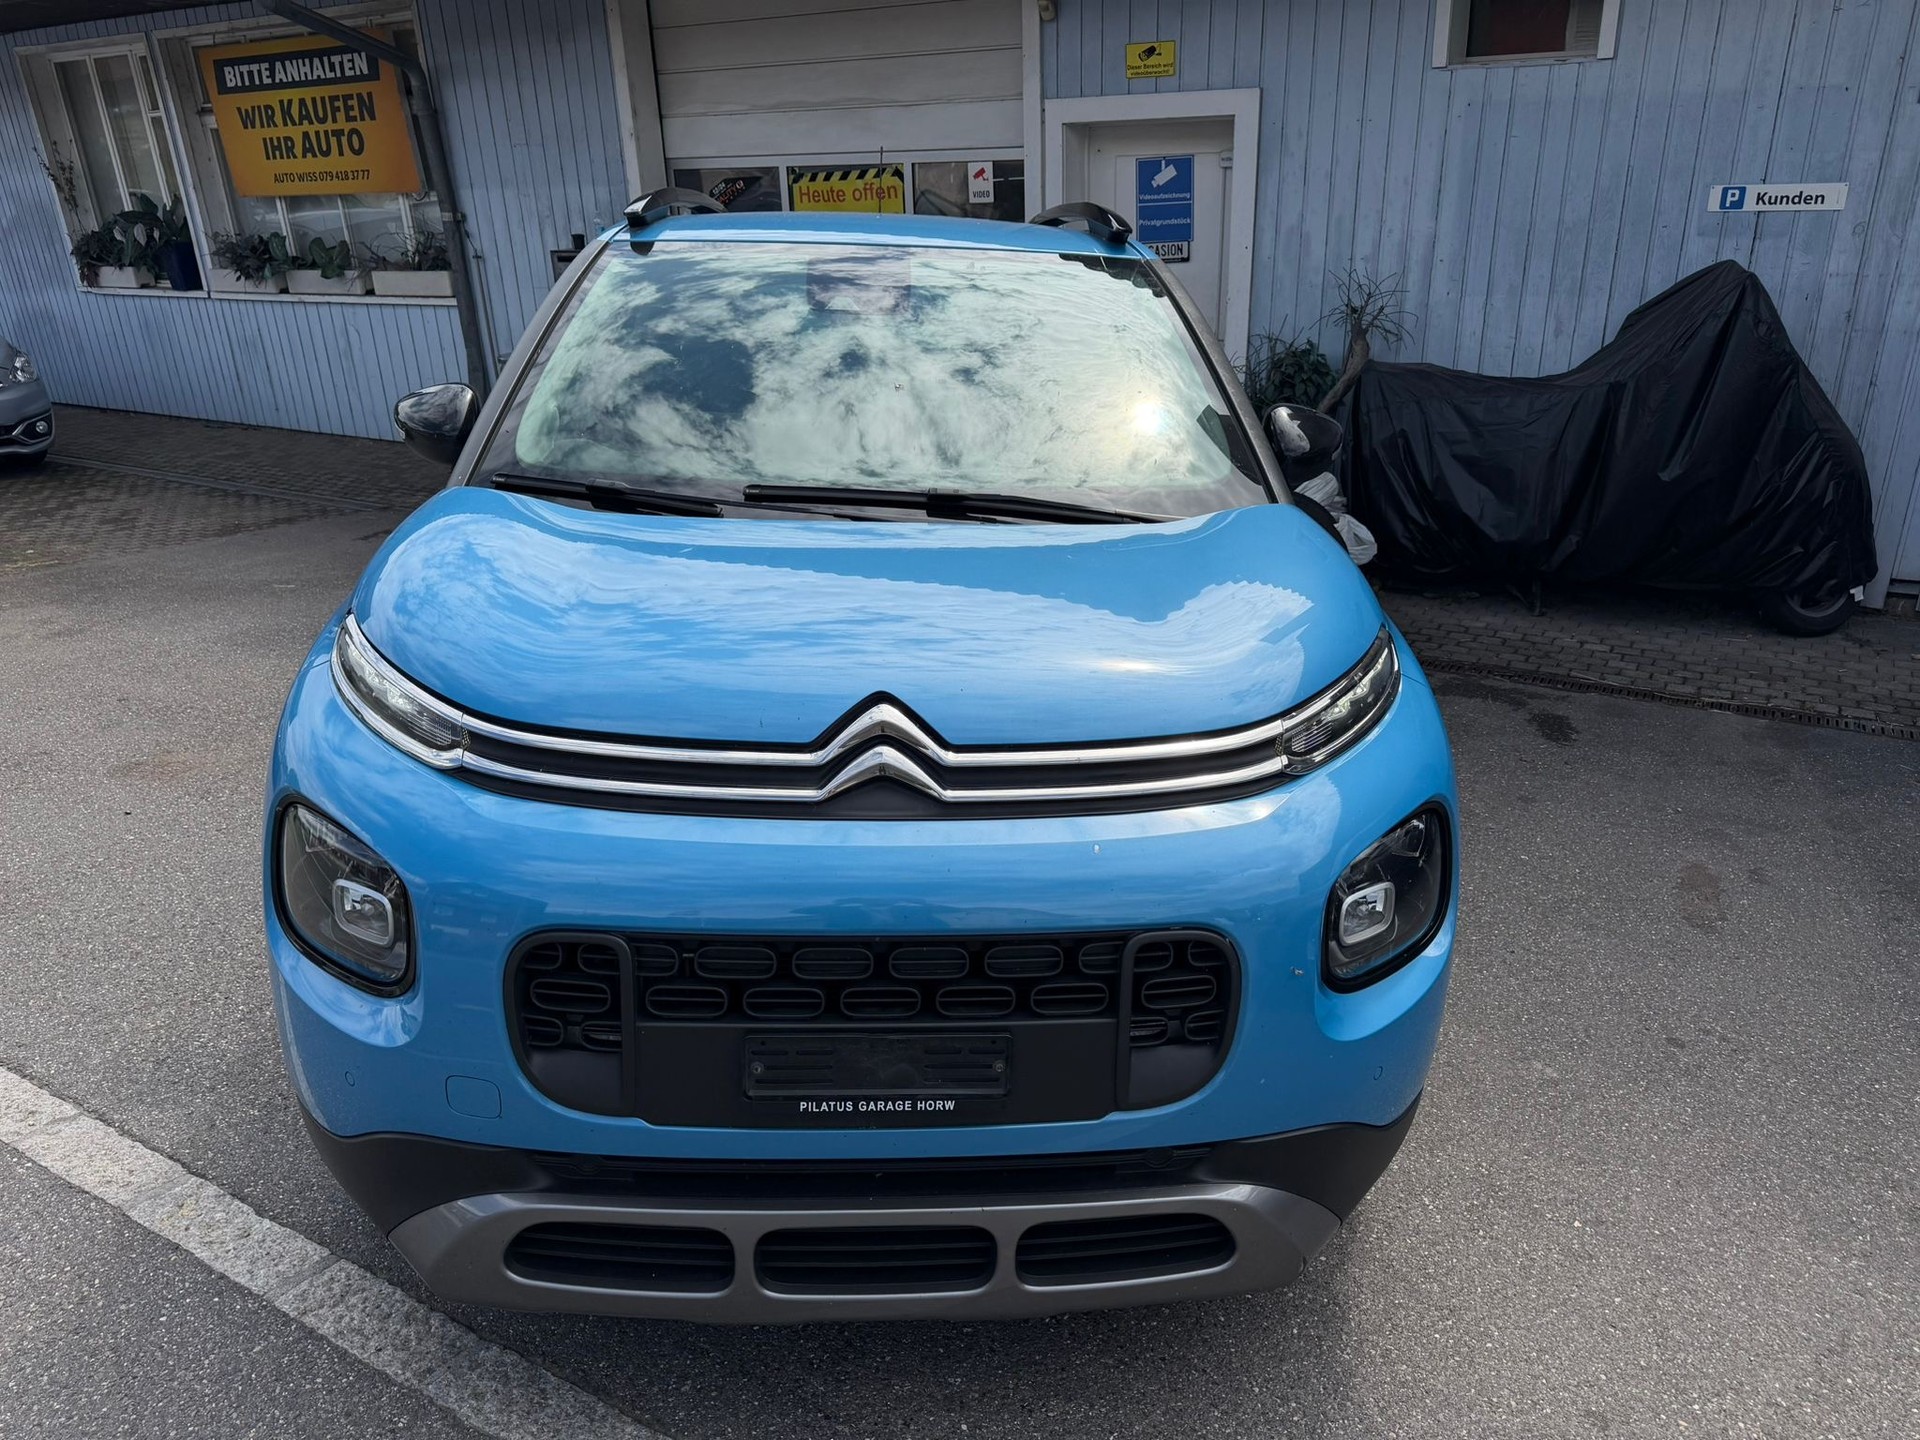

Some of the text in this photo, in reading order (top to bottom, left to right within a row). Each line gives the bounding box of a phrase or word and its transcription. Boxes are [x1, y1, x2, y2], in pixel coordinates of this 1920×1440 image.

[223, 51, 369, 88] BITTE ANHALTEN
[236, 91, 377, 130] WIR KAUFEN
[262, 127, 366, 161] IHR AUTO
[273, 173, 296, 184] AUTO
[296, 171, 318, 183] WISS
[318, 171, 334, 182] 079
[335, 170, 350, 181] 418
[799, 180, 899, 204] Heute offen
[972, 190, 991, 199] VIDEO
[1755, 190, 1826, 206] Kunden
[800, 1100, 956, 1112] PILATUS GARAGE HORW
